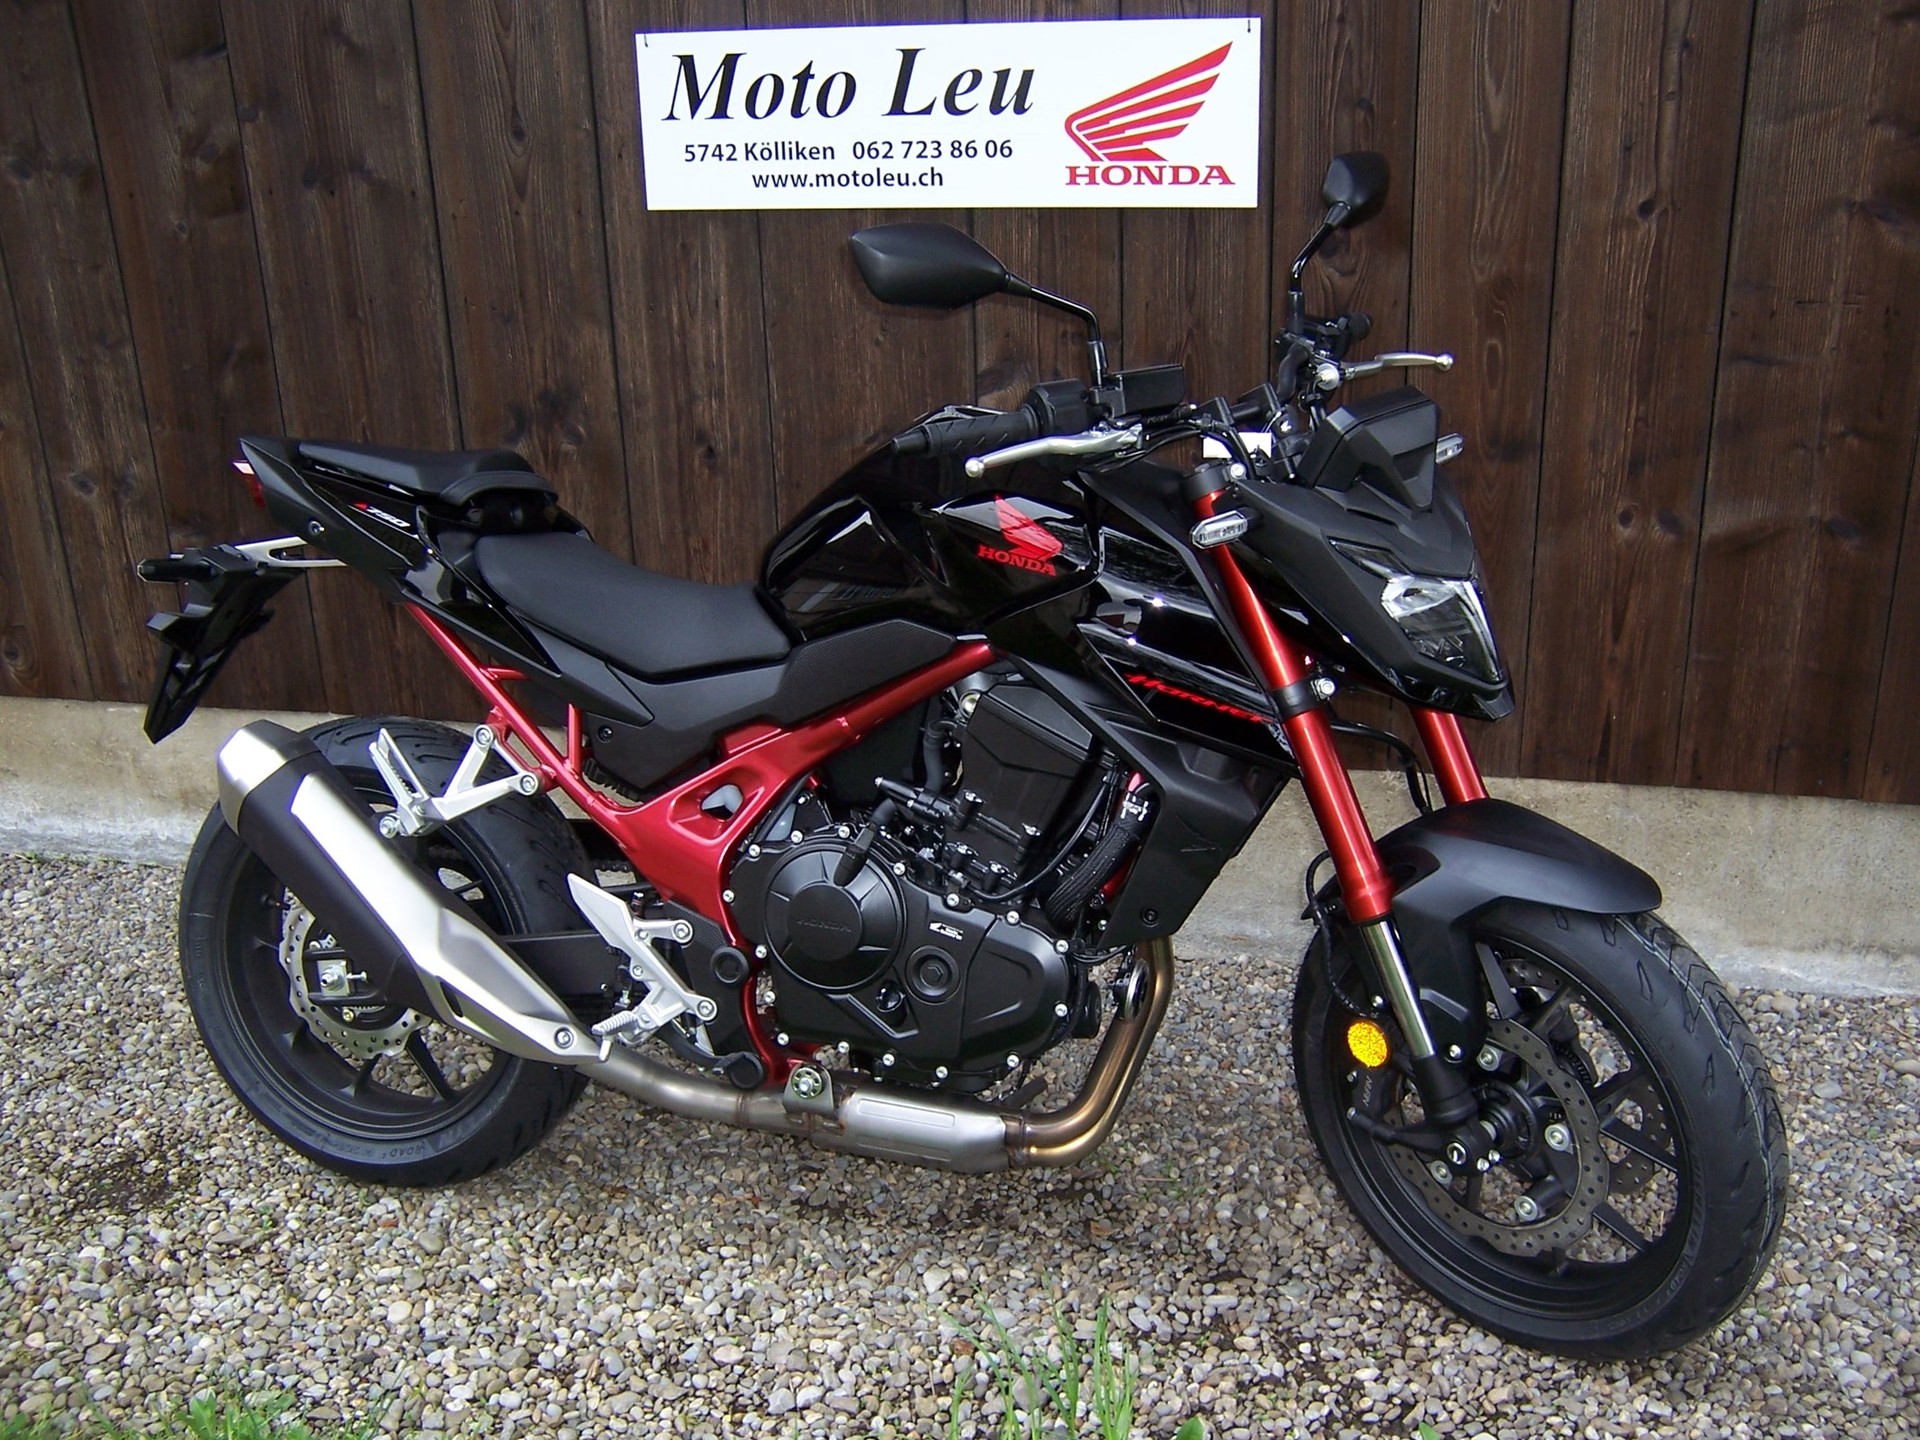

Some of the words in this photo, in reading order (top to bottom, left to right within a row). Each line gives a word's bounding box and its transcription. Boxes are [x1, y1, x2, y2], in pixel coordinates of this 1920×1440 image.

[661, 52, 857, 121] Moto
[881, 47, 1035, 117] Leu
[684, 143, 738, 163] 5742
[744, 140, 835, 161] Kölliken
[852, 140, 894, 160] 062
[900, 140, 943, 159] 723
[950, 139, 978, 159] 86
[984, 139, 1013, 159] 06
[751, 166, 944, 188] www.motoleu.ch
[1065, 165, 1236, 186] HONDA
[977, 545, 1057, 577] HONDA
[796, 917, 852, 934] HONDA
